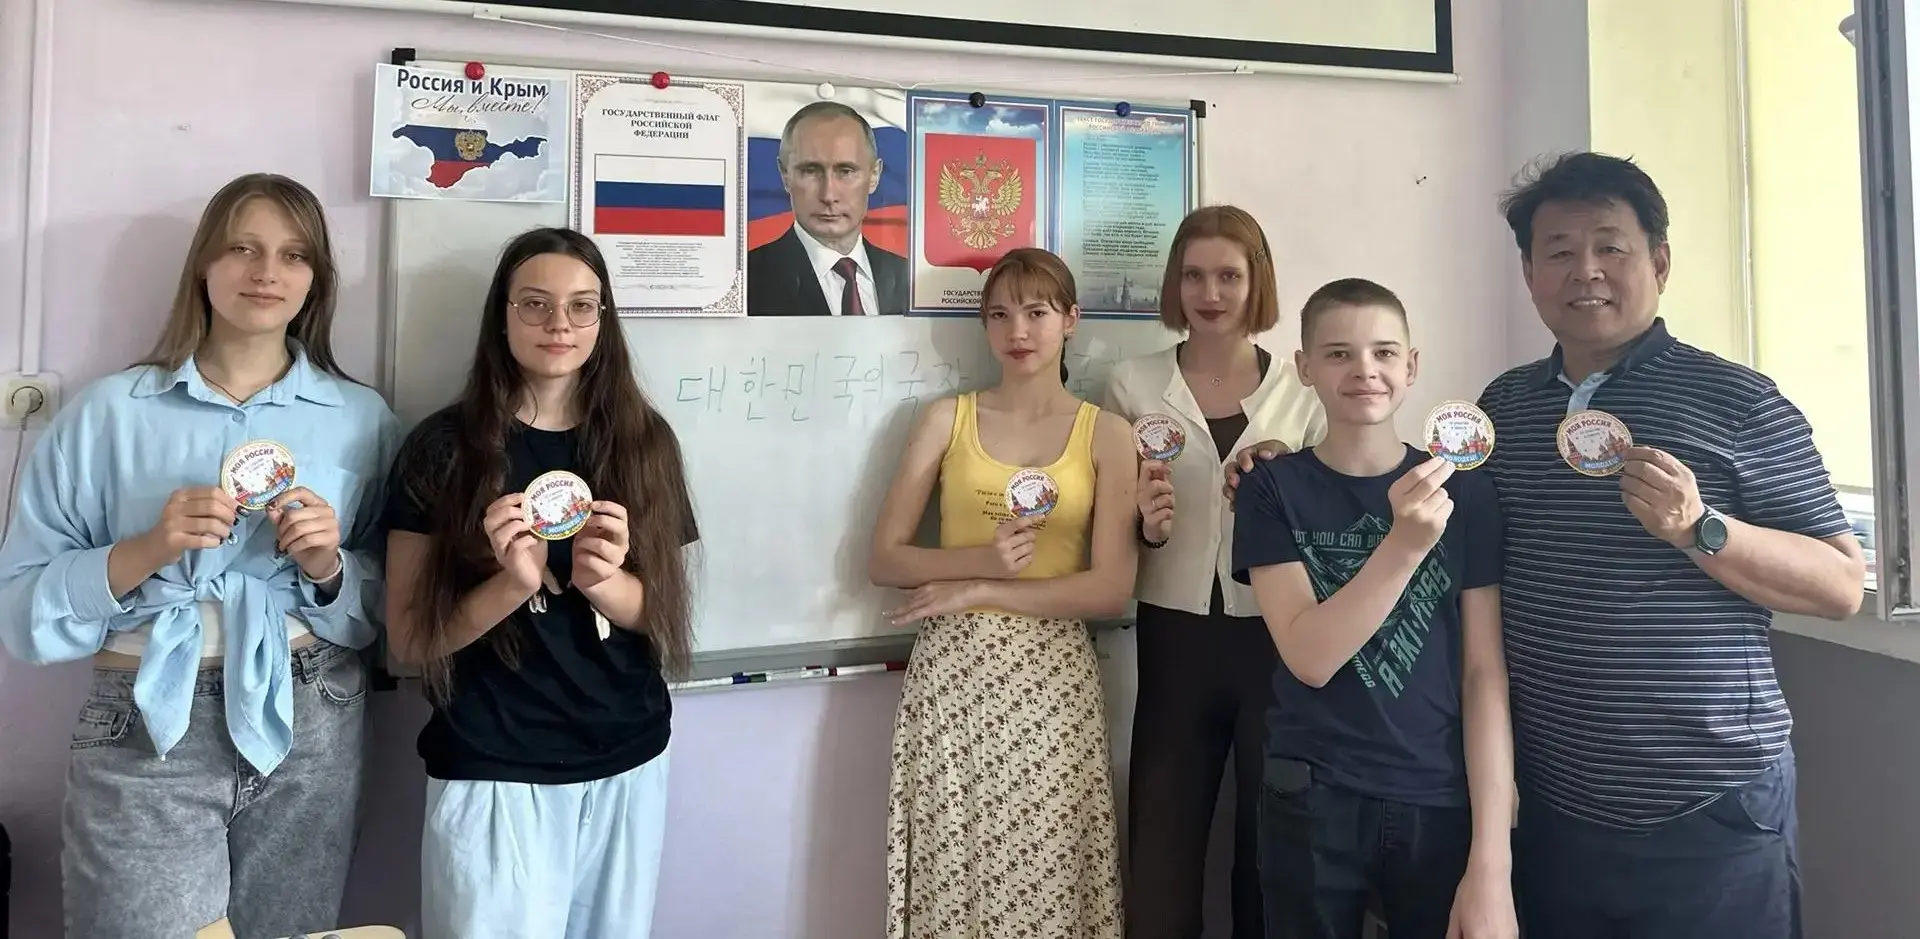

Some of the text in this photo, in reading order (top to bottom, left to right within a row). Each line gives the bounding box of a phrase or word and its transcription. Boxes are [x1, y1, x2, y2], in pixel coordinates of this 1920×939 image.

[397, 69, 546, 100] Россия и Крым
[602, 108, 694, 120] ГОСУДАРСТВЕННЫЙ
[631, 119, 692, 129] РОССИЙСКОЙ
[634, 130, 689, 139] ФЕДЕРАЦИИ
[1436, 410, 1482, 424] МОЯ РОССИЯ
[1566, 422, 1582, 435] МОЯ
[1582, 419, 1612, 428] РОССИЯ
[230, 459, 245, 474] МОЯ
[245, 448, 274, 460] РОССИЯ
[531, 487, 545, 501] МОЯ
[546, 479, 574, 490] РОССИЯ
[1011, 478, 1022, 490] МОЯ
[1022, 474, 1045, 483] РОССИЯ
[1292, 529, 1307, 544] UT
[1313, 529, 1335, 545] YOU
[1340, 533, 1362, 548] CAN
